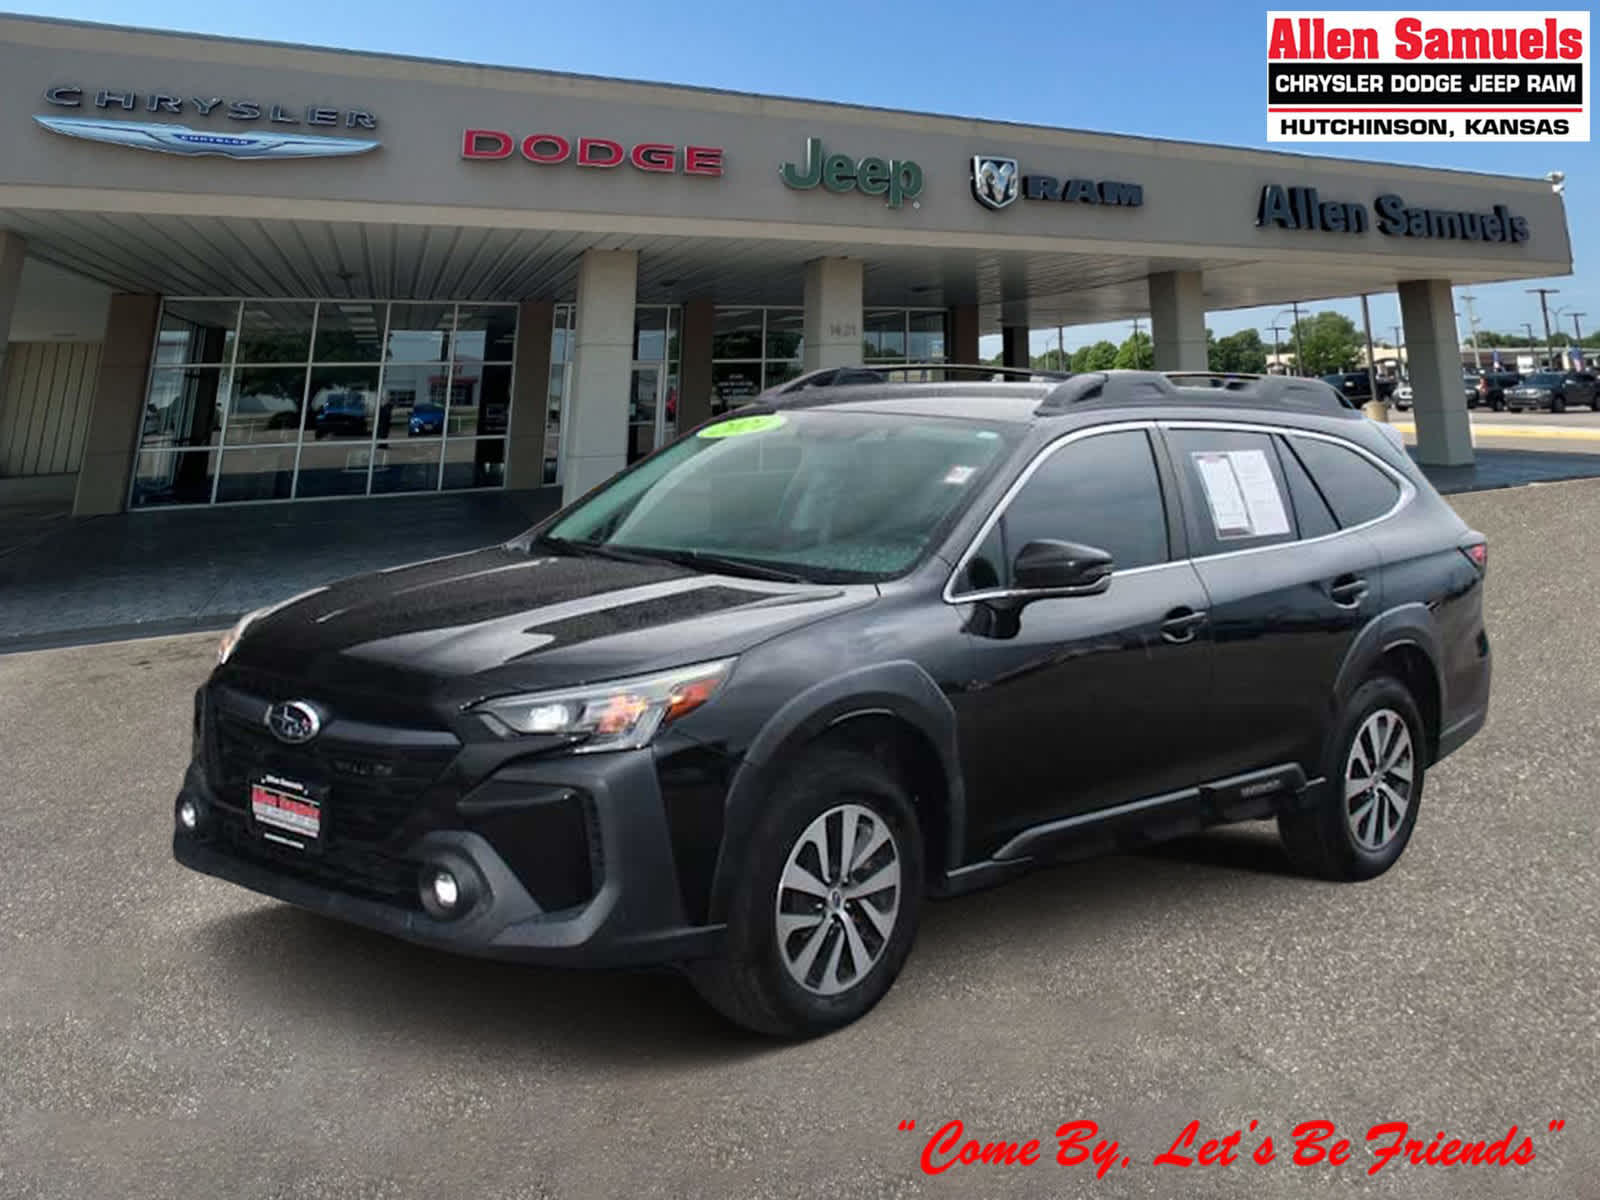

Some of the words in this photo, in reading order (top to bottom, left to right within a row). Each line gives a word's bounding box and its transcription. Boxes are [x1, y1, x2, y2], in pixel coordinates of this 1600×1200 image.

[44, 86, 378, 130] CHRYSLER
[461, 128, 725, 177] DODGE
[780, 136, 924, 209] Jeep
[1022, 175, 1144, 207] RAM
[1256, 184, 1370, 233] Allen
[1374, 193, 1531, 243] Samuels
